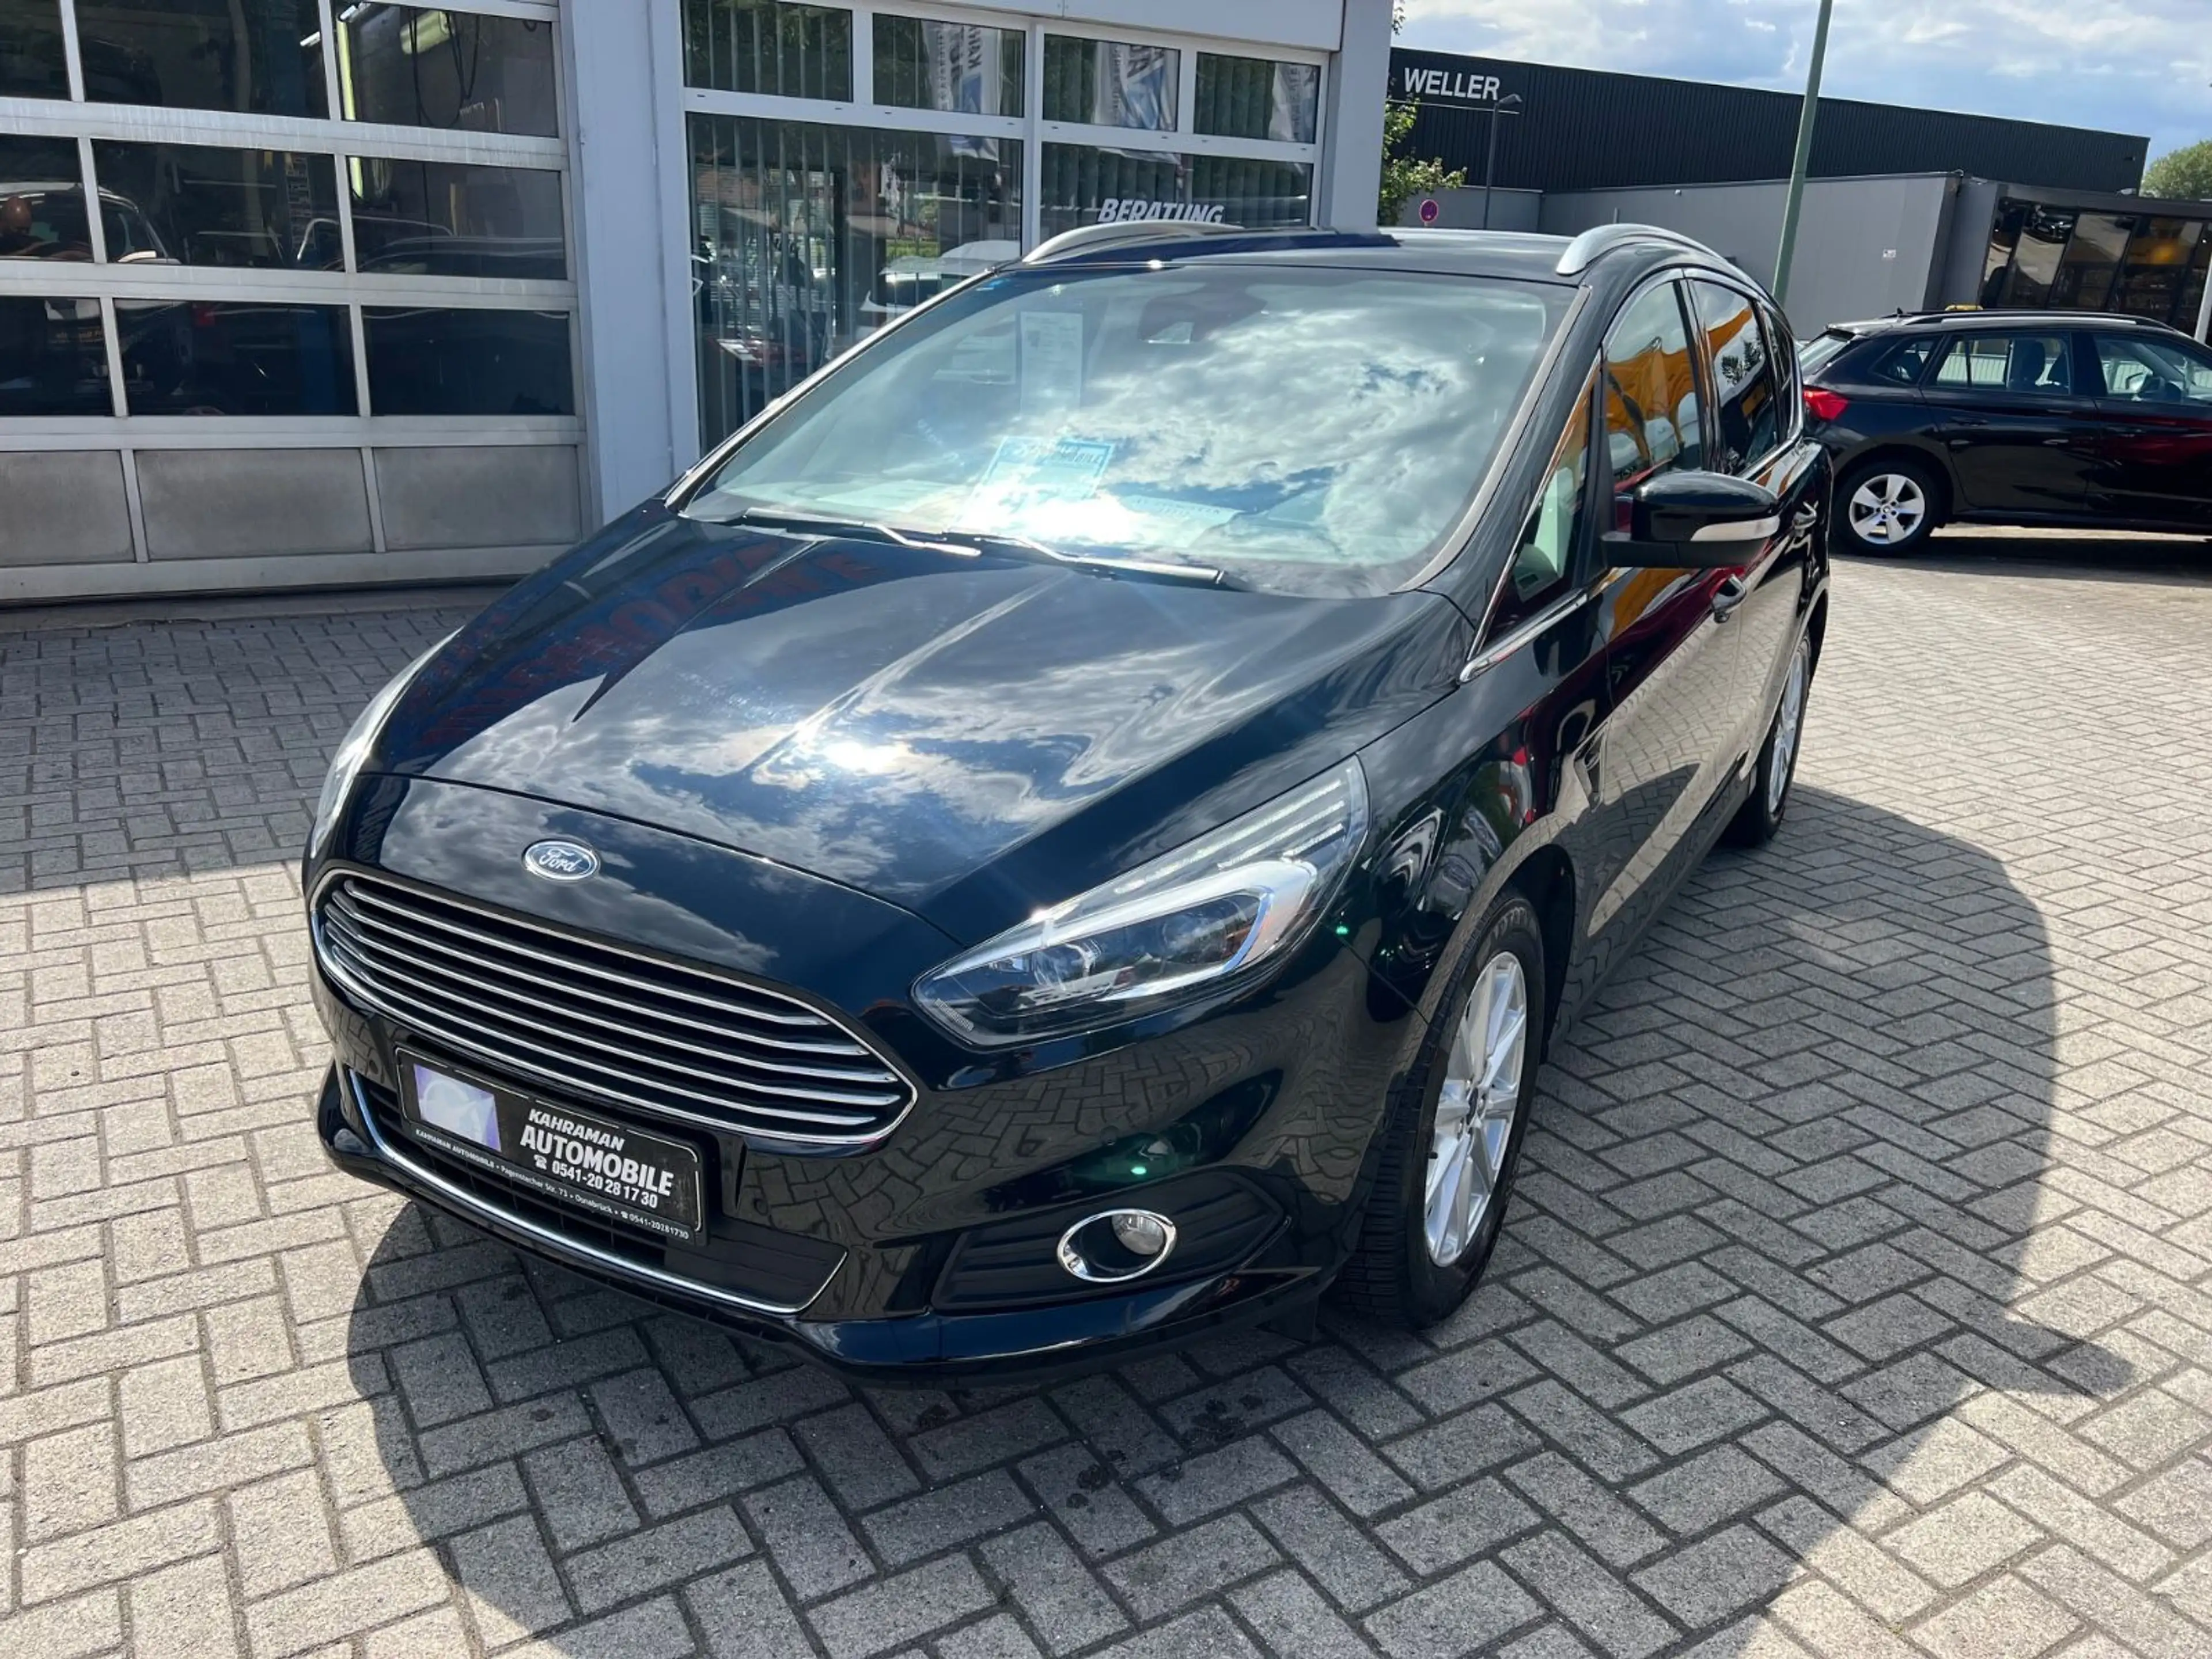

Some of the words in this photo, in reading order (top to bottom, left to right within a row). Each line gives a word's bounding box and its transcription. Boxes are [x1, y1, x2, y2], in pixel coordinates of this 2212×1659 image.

[1404, 67, 1500, 100] WELLER
[1097, 198, 1224, 224] BERATUNG
[539, 849, 582, 872] Ford
[528, 1108, 625, 1151] KAHRAMAN
[520, 1125, 674, 1196] AUTOMOBILE
[551, 1160, 603, 1190] 0541-20
[605, 1180, 622, 1196] 28
[624, 1185, 639, 1201] 17
[641, 1191, 658, 1209] 30
